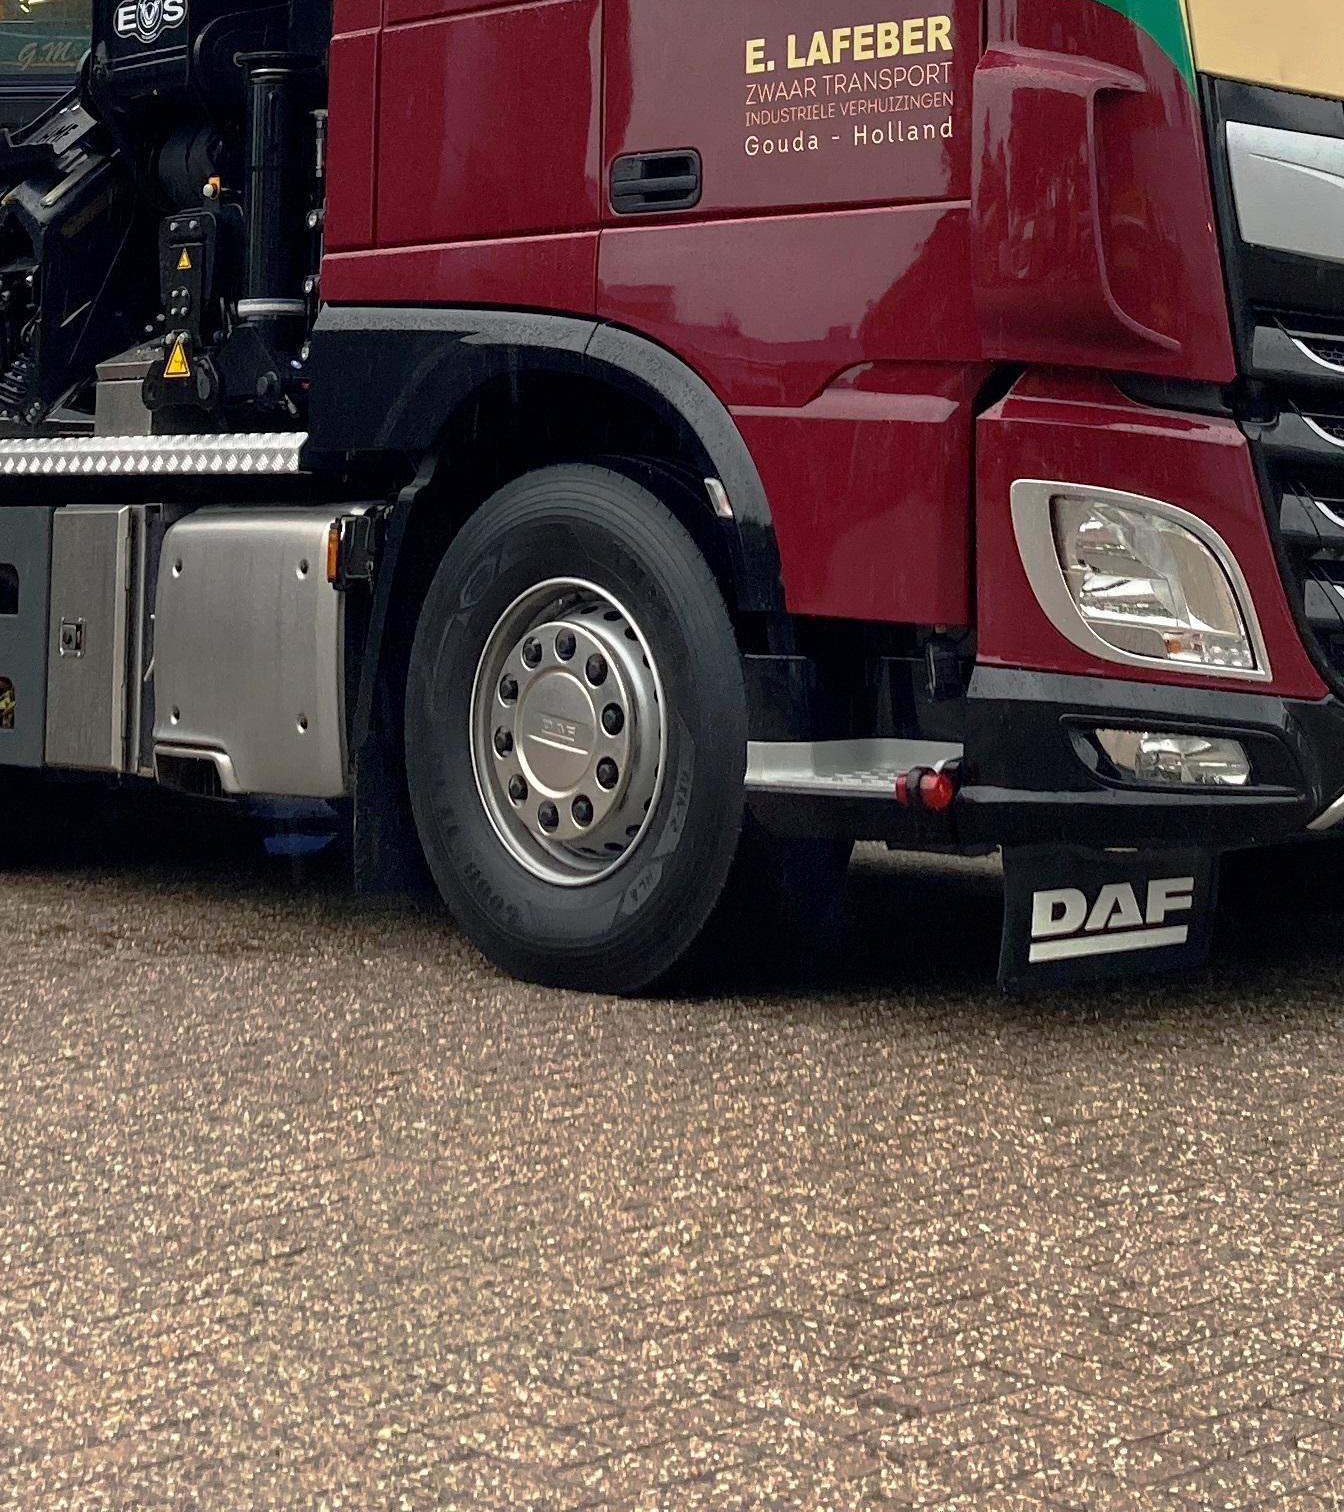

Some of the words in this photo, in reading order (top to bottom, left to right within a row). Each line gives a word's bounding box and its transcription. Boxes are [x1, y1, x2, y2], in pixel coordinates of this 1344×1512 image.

[745, 38, 775, 74] E.
[787, 15, 953, 69] LAFEBER
[745, 77, 817, 105] ZWAAR
[822, 61, 953, 96] TRANSPORT
[839, 91, 953, 117] VERHUIZINGEN
[745, 130, 819, 156] Gouda
[853, 115, 953, 146] Holland
[1031, 876, 1195, 938] DAF
